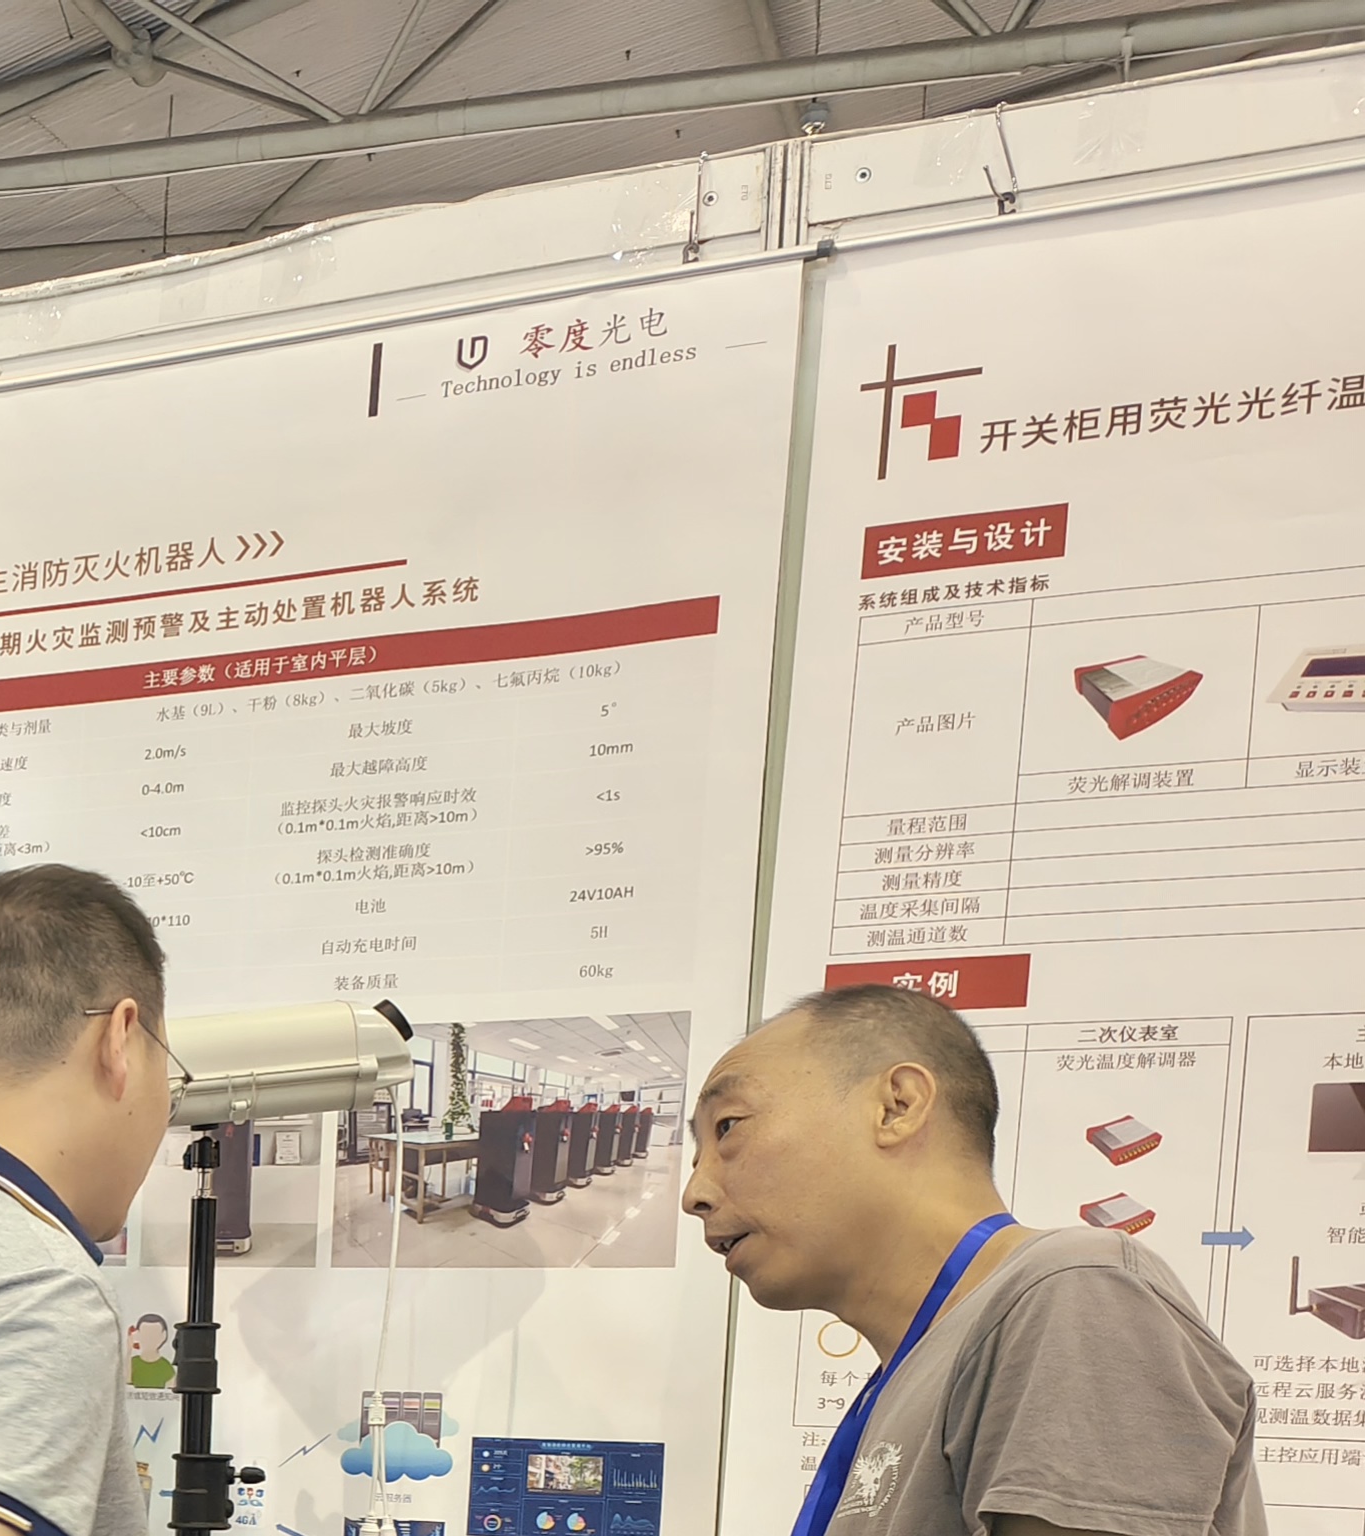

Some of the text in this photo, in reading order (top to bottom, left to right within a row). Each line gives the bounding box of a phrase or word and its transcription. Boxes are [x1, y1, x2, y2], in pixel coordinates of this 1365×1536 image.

[519, 306, 669, 360] 零度光电
[441, 344, 698, 399] Technology is endless
[980, 373, 1365, 454] 开关柜用荧光光纤温
[876, 518, 1053, 566] 安装与设计
[858, 573, 1051, 611] 系统组成及技术指标
[903, 610, 985, 635] 产品型号
[347, 718, 414, 741] 最大坡度
[895, 711, 976, 736] 产品图片
[144, 745, 187, 761] 2.0m/s
[588, 740, 634, 758] 10mm
[330, 755, 428, 778] 最大越障高度
[141, 782, 185, 797] 0-4.0m
[1067, 768, 1195, 794] 荧光解调装置
[280, 788, 477, 817] 监控探头火灾报警响应时效
[596, 789, 621, 802] <1s
[140, 825, 181, 839] <10cm
[886, 812, 968, 836] 量程范围
[316, 842, 432, 865] 探头检测准确度
[585, 840, 624, 857] >95%
[873, 840, 976, 866] 测量分辨率
[881, 869, 963, 891] 测量精度
[569, 885, 635, 903] 24V10AH
[355, 897, 387, 916] 电池
[859, 896, 981, 921] 温度采集间隔
[590, 925, 609, 941] 5H
[866, 925, 968, 949] 测温通道数
[321, 934, 418, 957] 自动充电时间
[334, 973, 399, 992] 装备质量
[579, 963, 615, 981] 60kg
[1077, 1023, 1180, 1045] 二次仪表室
[1055, 1050, 1197, 1072] 荧光温度解调器
[1327, 1226, 1365, 1245] 智能
[1257, 1446, 1365, 1467] 主控应用端
